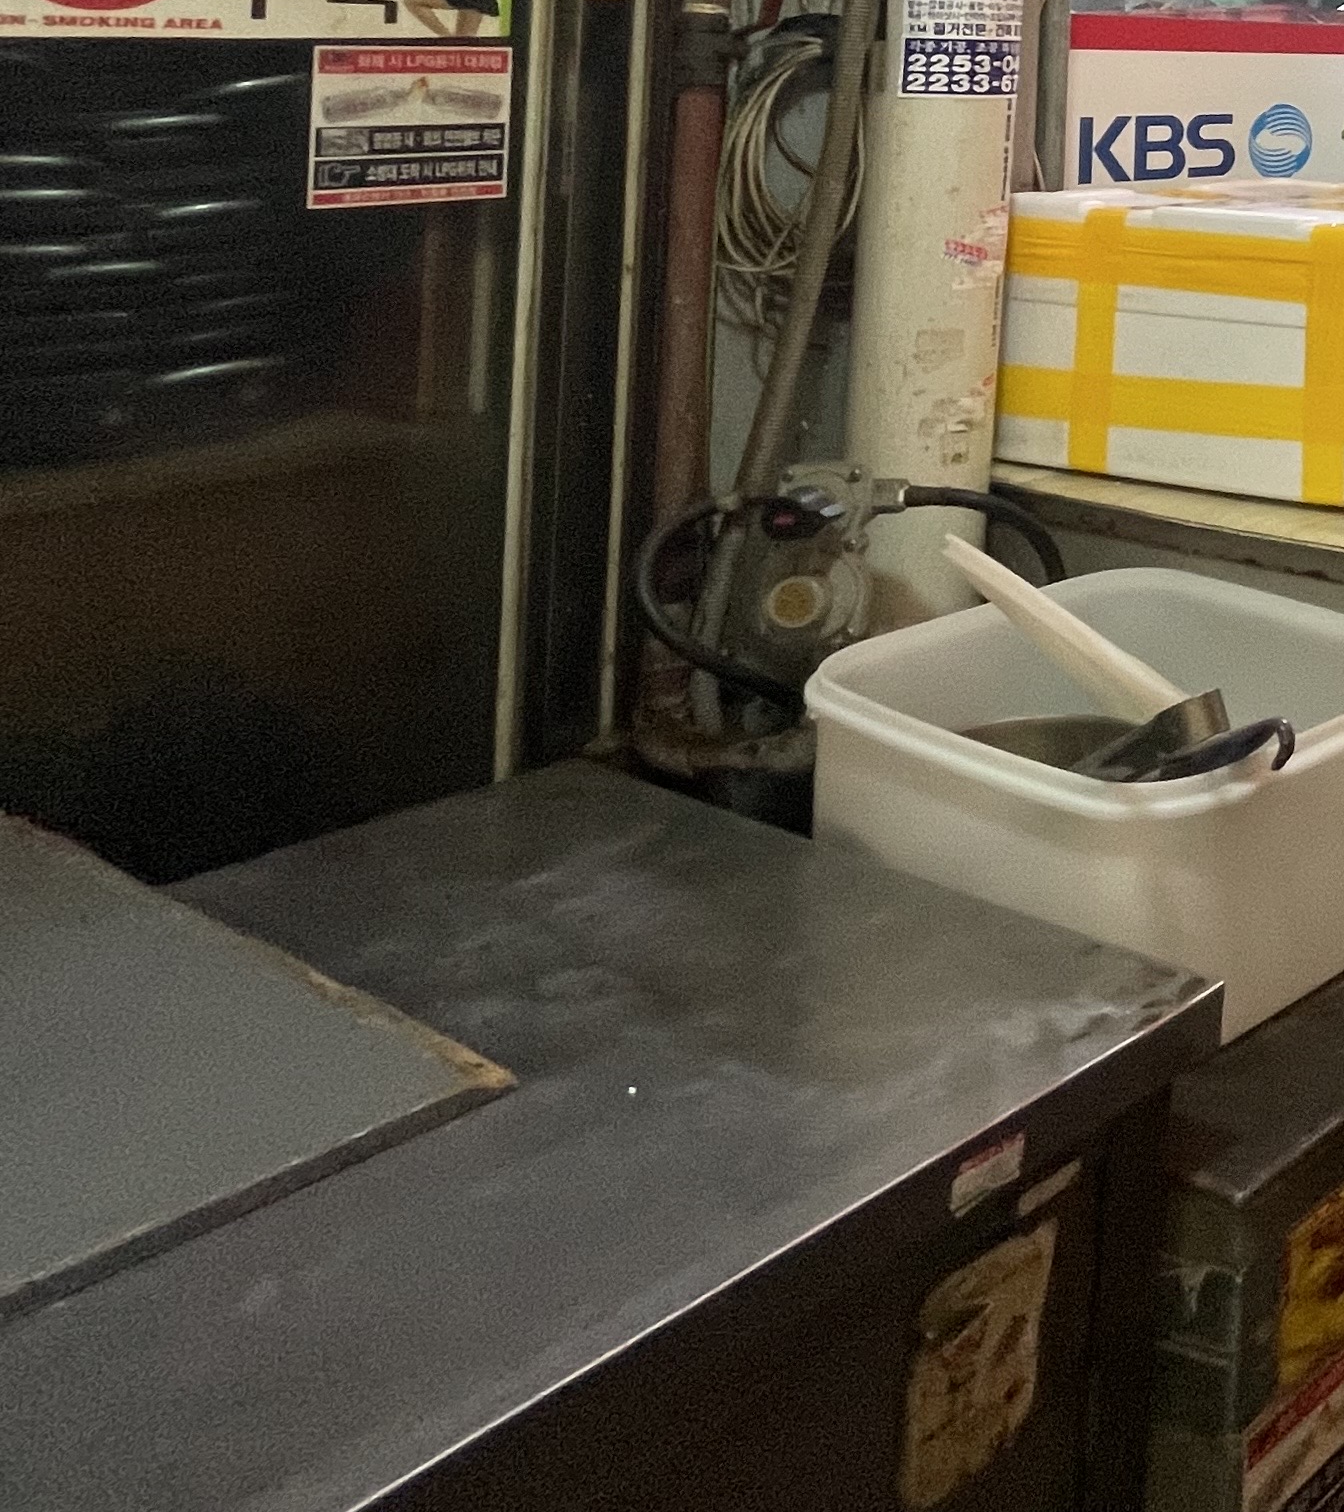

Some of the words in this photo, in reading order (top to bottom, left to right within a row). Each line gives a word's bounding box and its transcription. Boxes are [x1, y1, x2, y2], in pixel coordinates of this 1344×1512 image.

[42, 14, 156, 29] SMOKING
[163, 17, 224, 30] AREA
[1077, 112, 1236, 186] KBS
